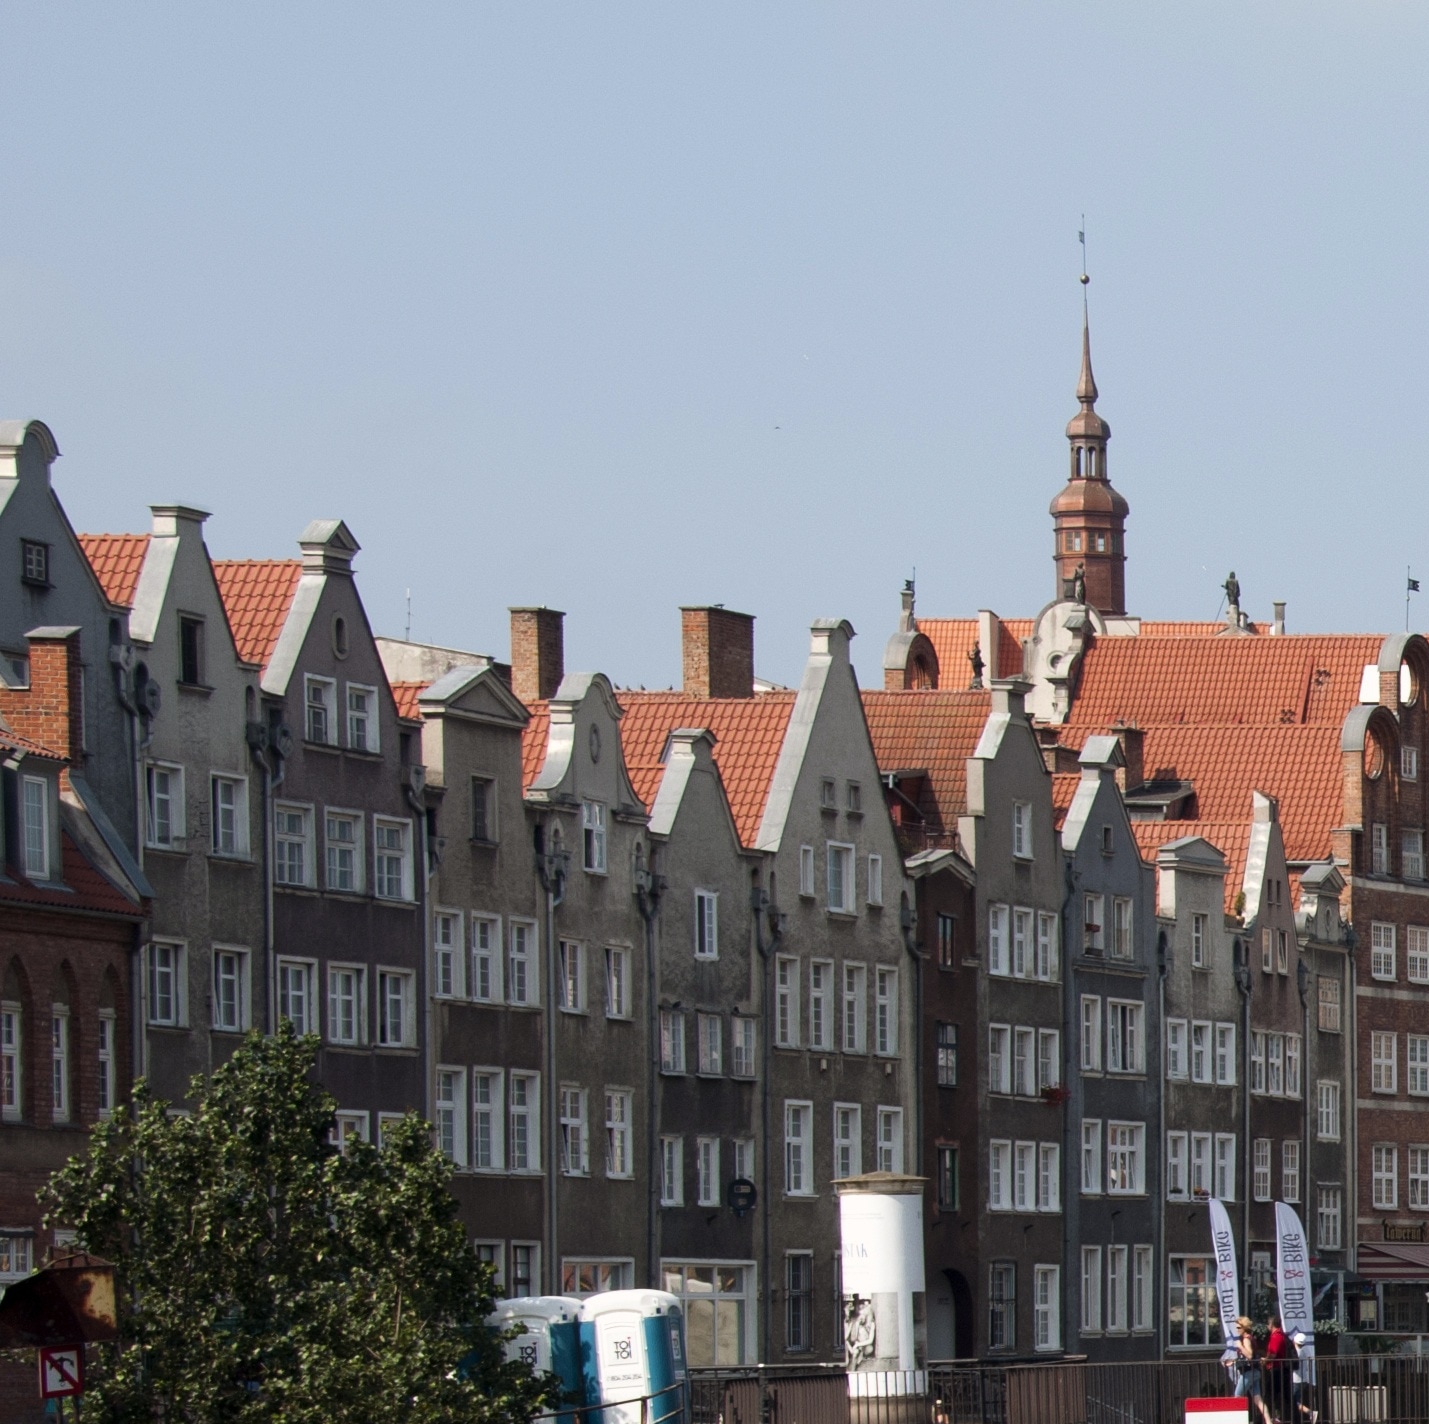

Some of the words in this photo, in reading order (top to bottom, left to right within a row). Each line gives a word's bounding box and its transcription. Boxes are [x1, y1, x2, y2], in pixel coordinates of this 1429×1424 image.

[1282, 1234, 1303, 1263] BIKE
[1284, 1269, 1304, 1279] &
[1283, 1286, 1307, 1320] BOAT
[518, 1342, 537, 1354] TOI
[614, 1337, 632, 1351] TOI
[615, 1349, 632, 1360] TOI
